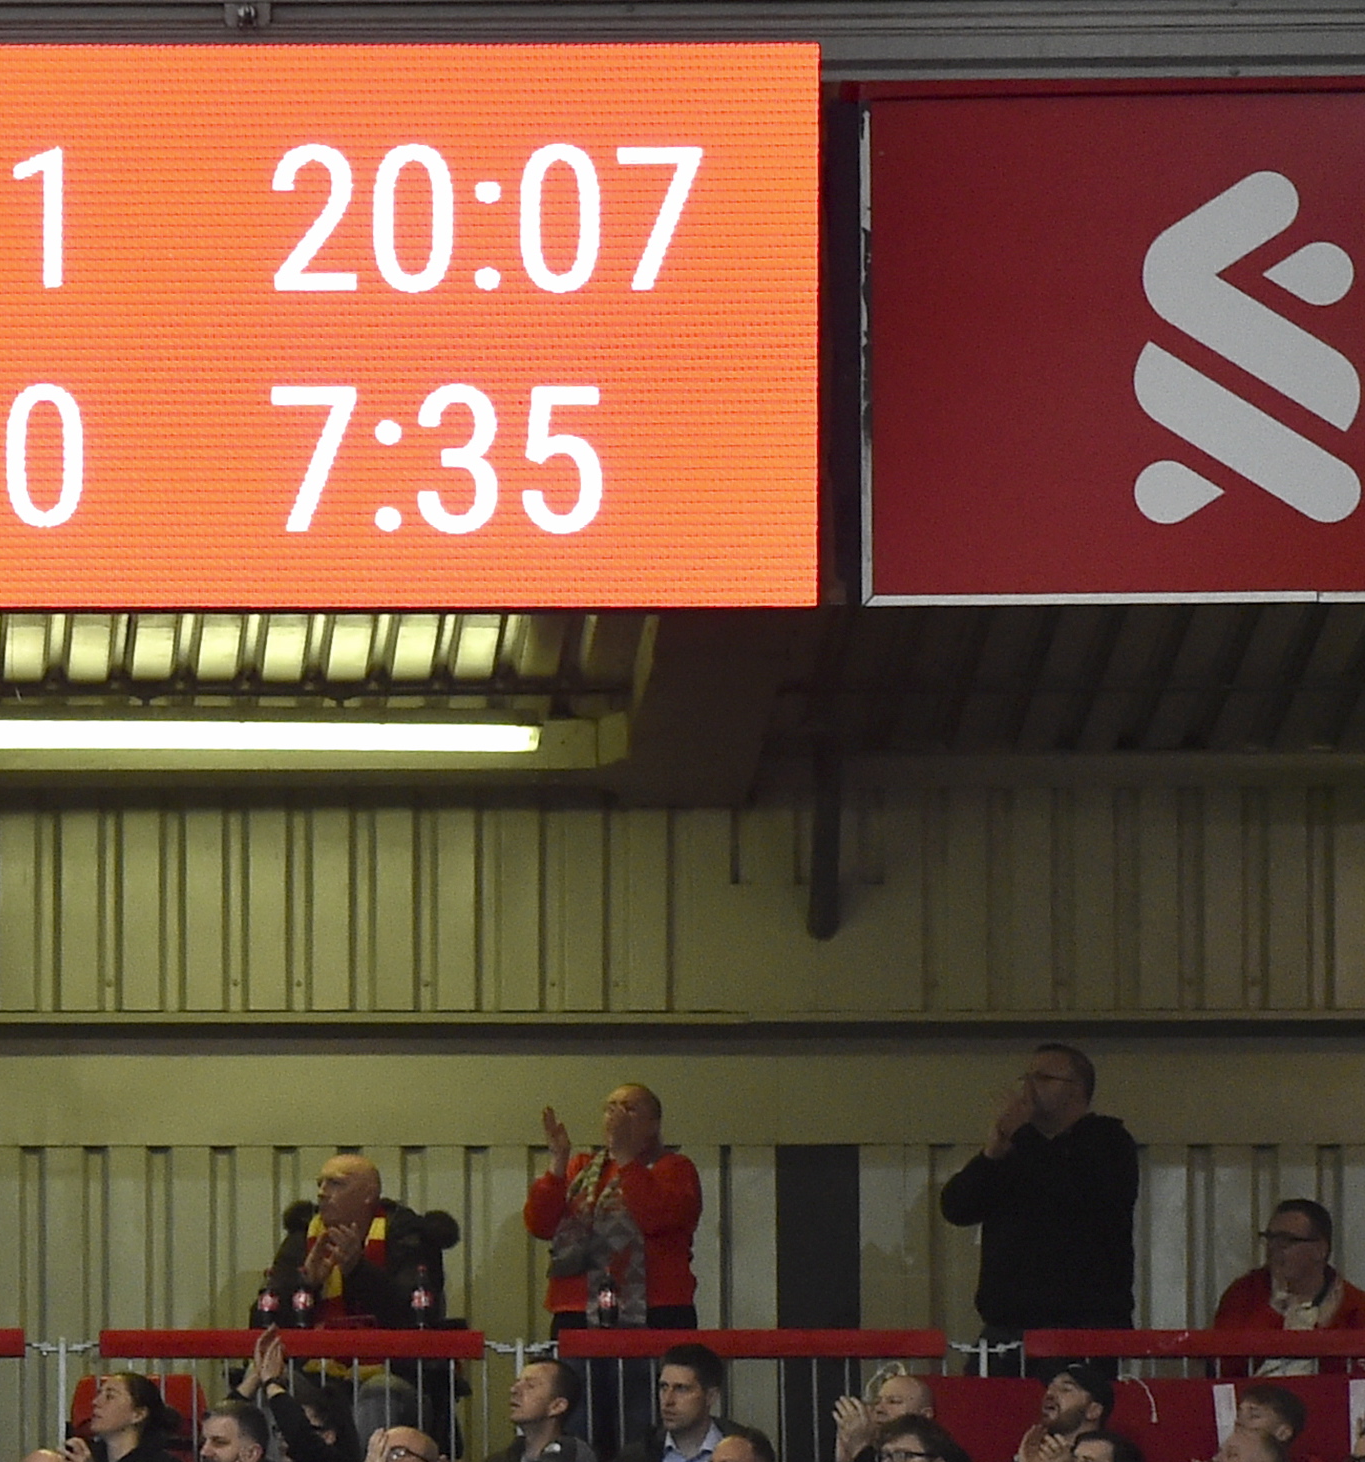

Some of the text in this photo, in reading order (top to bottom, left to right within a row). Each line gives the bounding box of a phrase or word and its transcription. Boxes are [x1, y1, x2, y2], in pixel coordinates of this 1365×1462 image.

[12, 145, 63, 289] 1
[272, 143, 703, 294] 20:07
[5, 383, 84, 528] 0
[271, 383, 603, 535] 7:35
